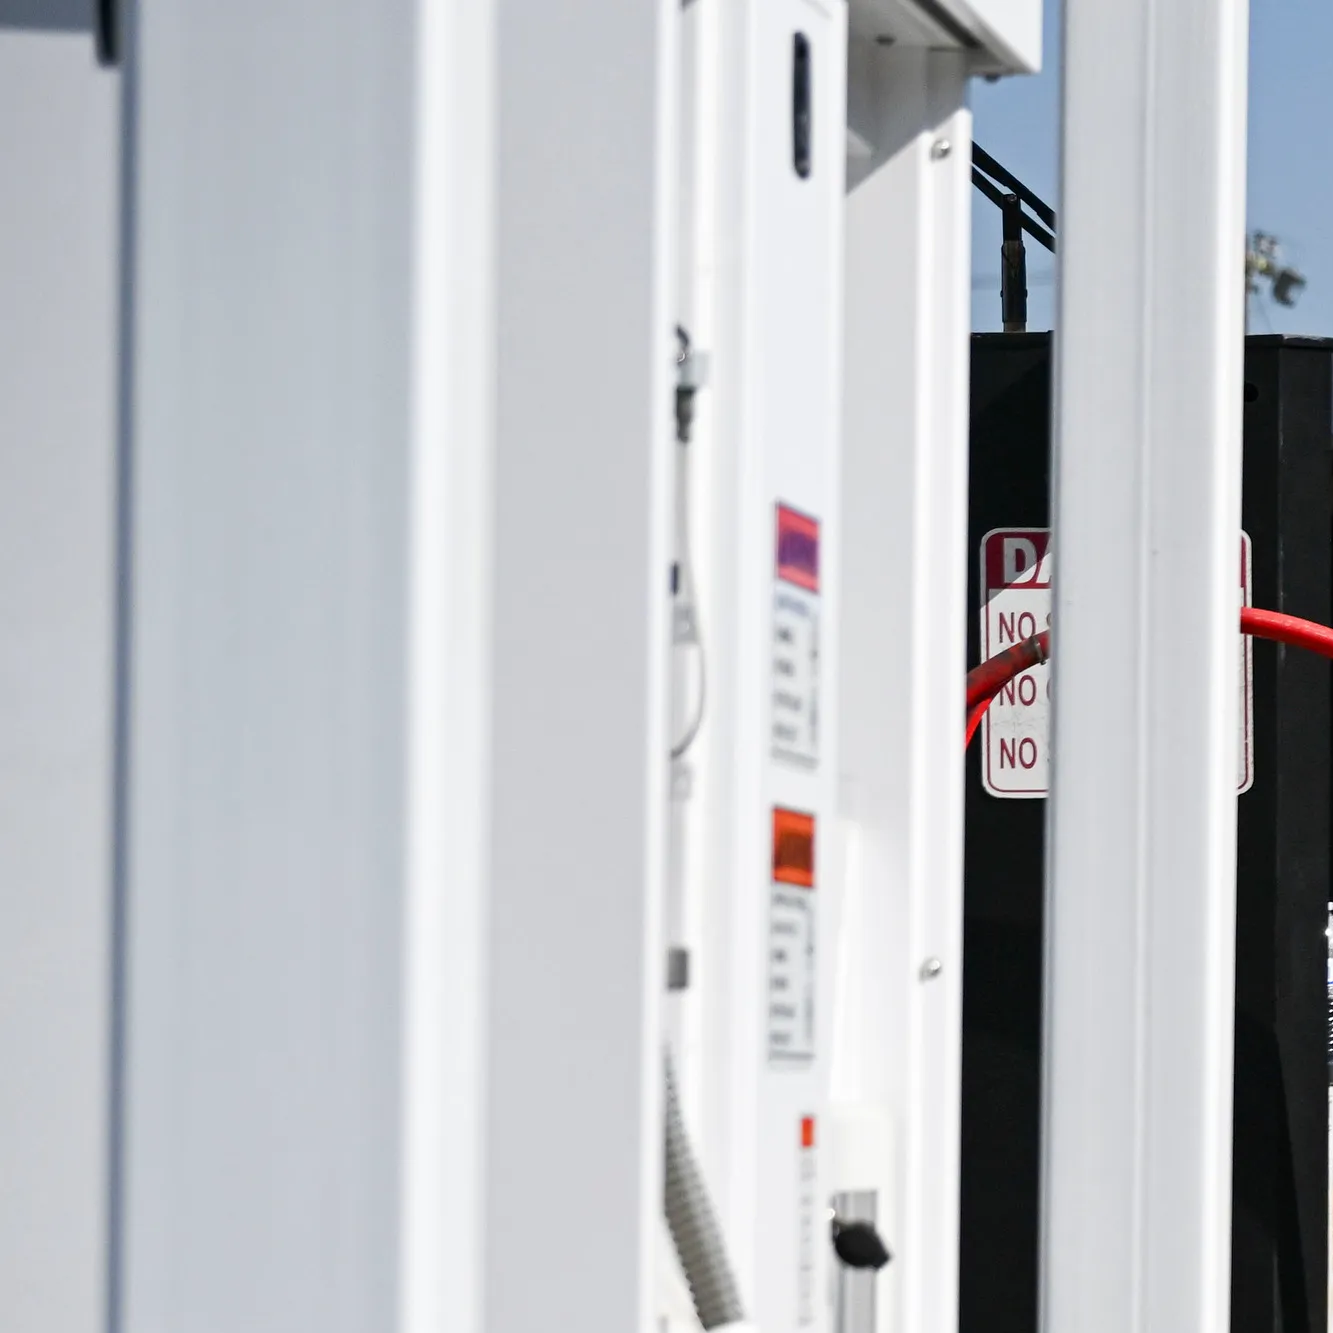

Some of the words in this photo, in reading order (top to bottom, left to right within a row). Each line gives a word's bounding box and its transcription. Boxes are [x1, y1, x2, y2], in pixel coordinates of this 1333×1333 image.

[999, 612, 1036, 643] NO
[999, 675, 1036, 706] NO
[999, 738, 1037, 769] NO
